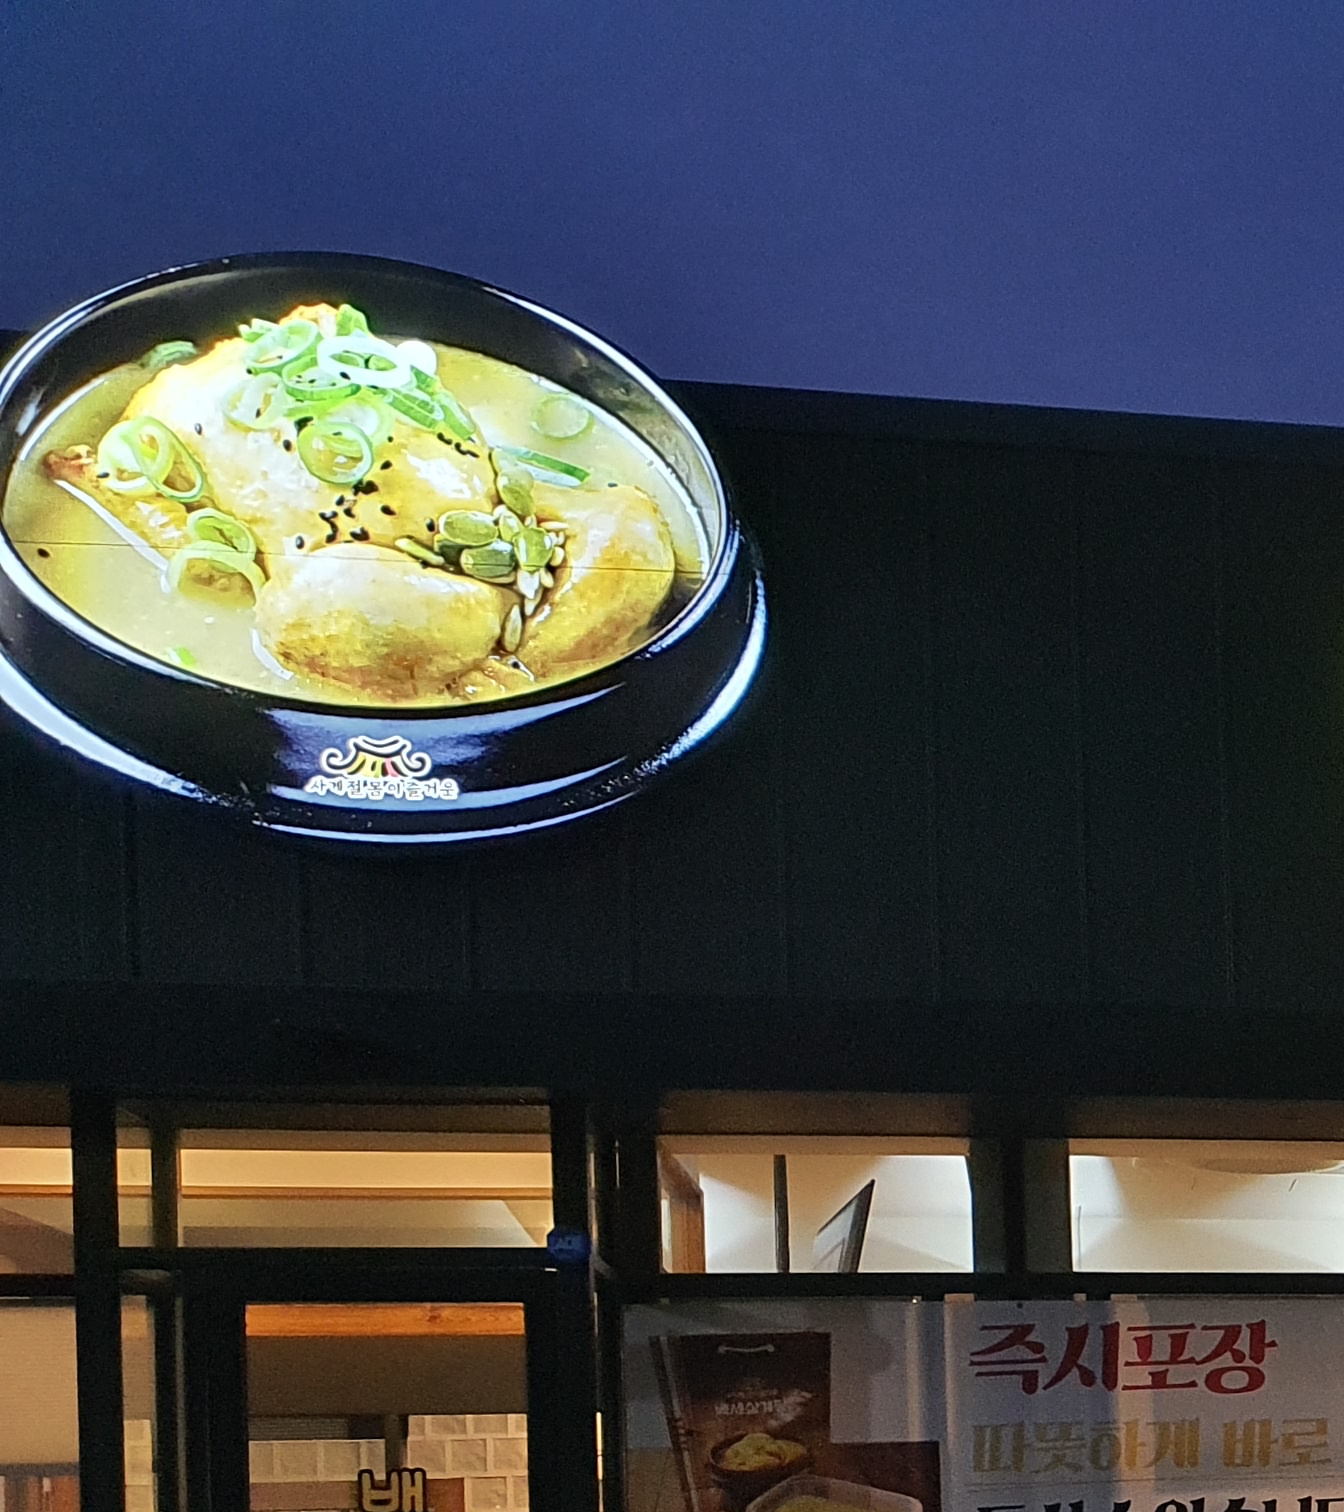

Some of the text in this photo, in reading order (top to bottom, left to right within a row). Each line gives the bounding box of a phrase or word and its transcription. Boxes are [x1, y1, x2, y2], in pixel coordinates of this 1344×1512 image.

[308, 776, 362, 798] 사계절
[968, 1318, 1279, 1395] 즉시포장
[971, 1416, 1333, 1474] 따뜻하게 바로
